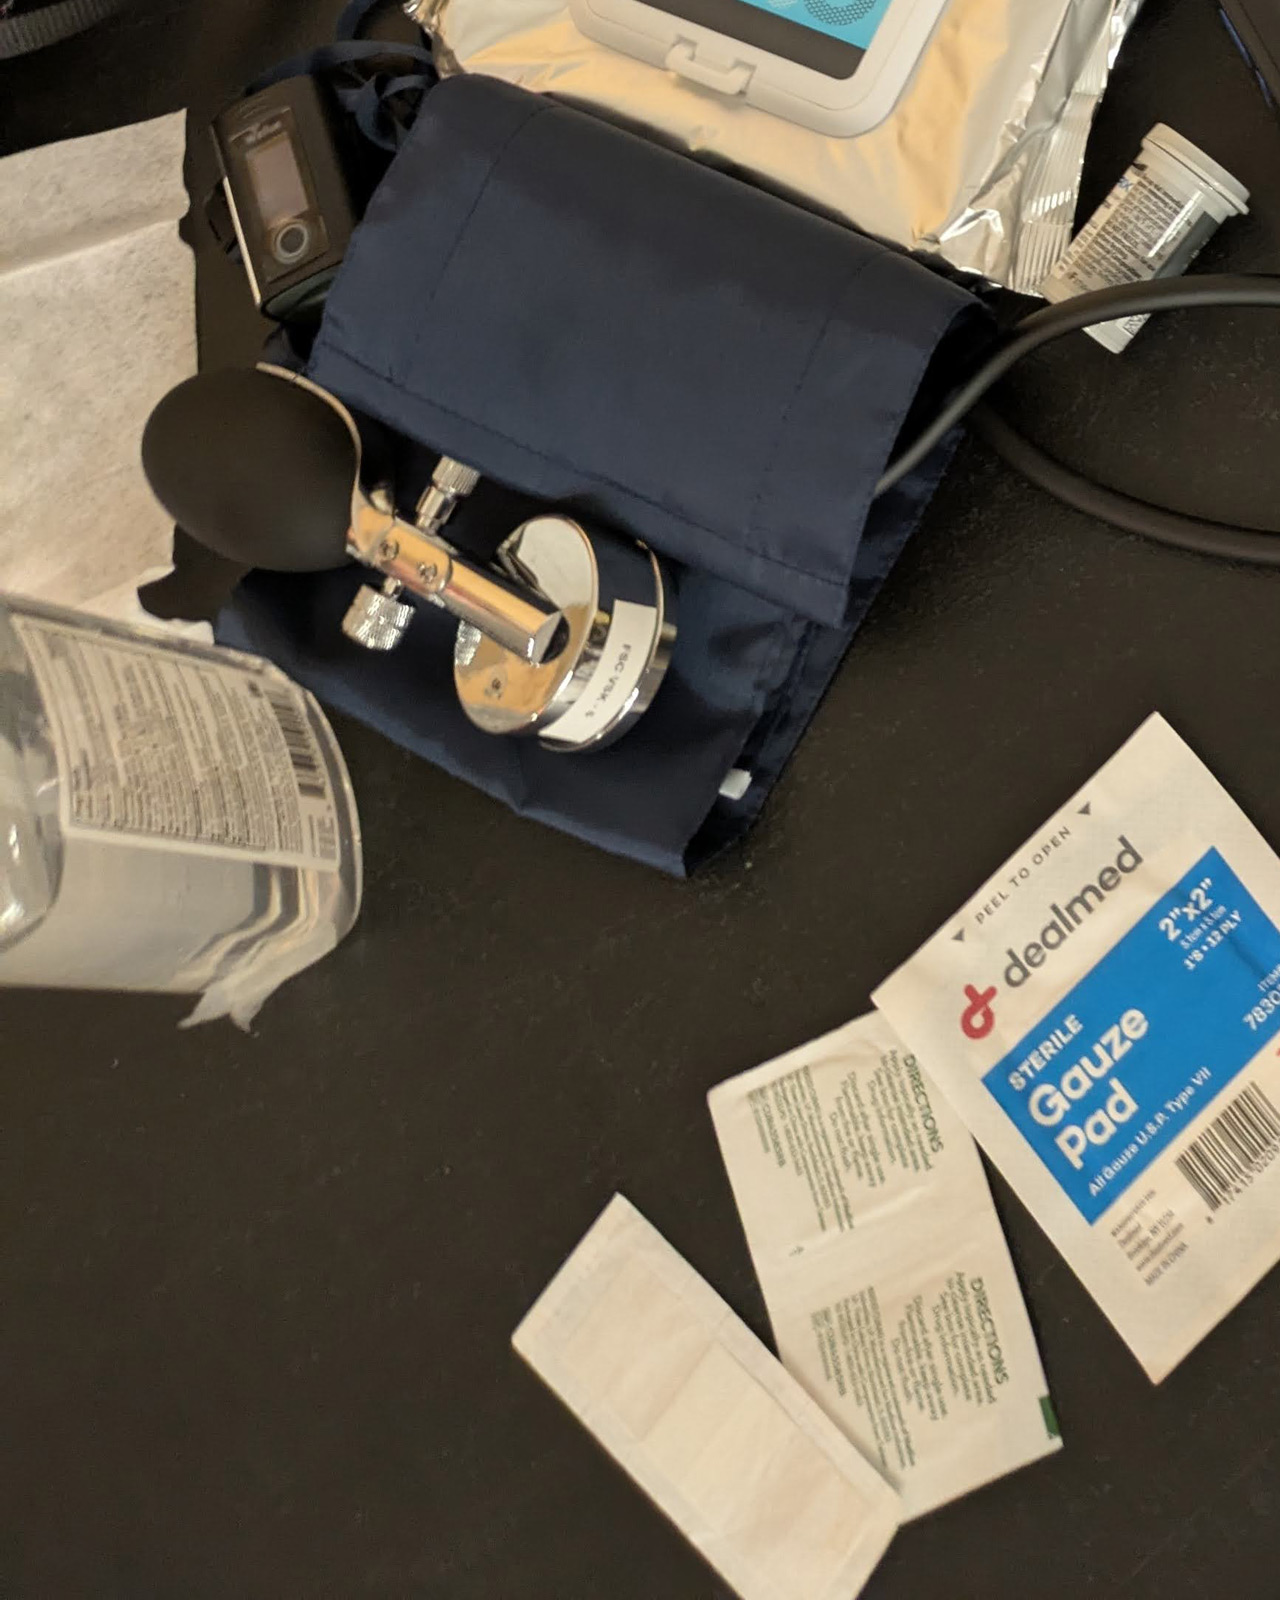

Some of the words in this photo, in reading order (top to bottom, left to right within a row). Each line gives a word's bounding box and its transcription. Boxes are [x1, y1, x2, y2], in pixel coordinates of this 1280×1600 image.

[975, 892, 1010, 925] PEEL
[1009, 867, 1030, 887] TO
[1032, 826, 1071, 866] OPEN
[1004, 835, 1144, 988] dealmed
[1219, 910, 1242, 934] PLY
[1009, 1014, 1083, 1090] STERILE
[1030, 1009, 1149, 1126] Gauze
[903, 1054, 944, 1153] DIRECTIONS
[1056, 1078, 1139, 1170] Pad
[1089, 1175, 1107, 1196] All
[1102, 1144, 1139, 1180] Gauze
[1164, 1086, 1195, 1113] Type
[1191, 1067, 1212, 1086] VII
[970, 1277, 1009, 1385] DIRECTIONS
